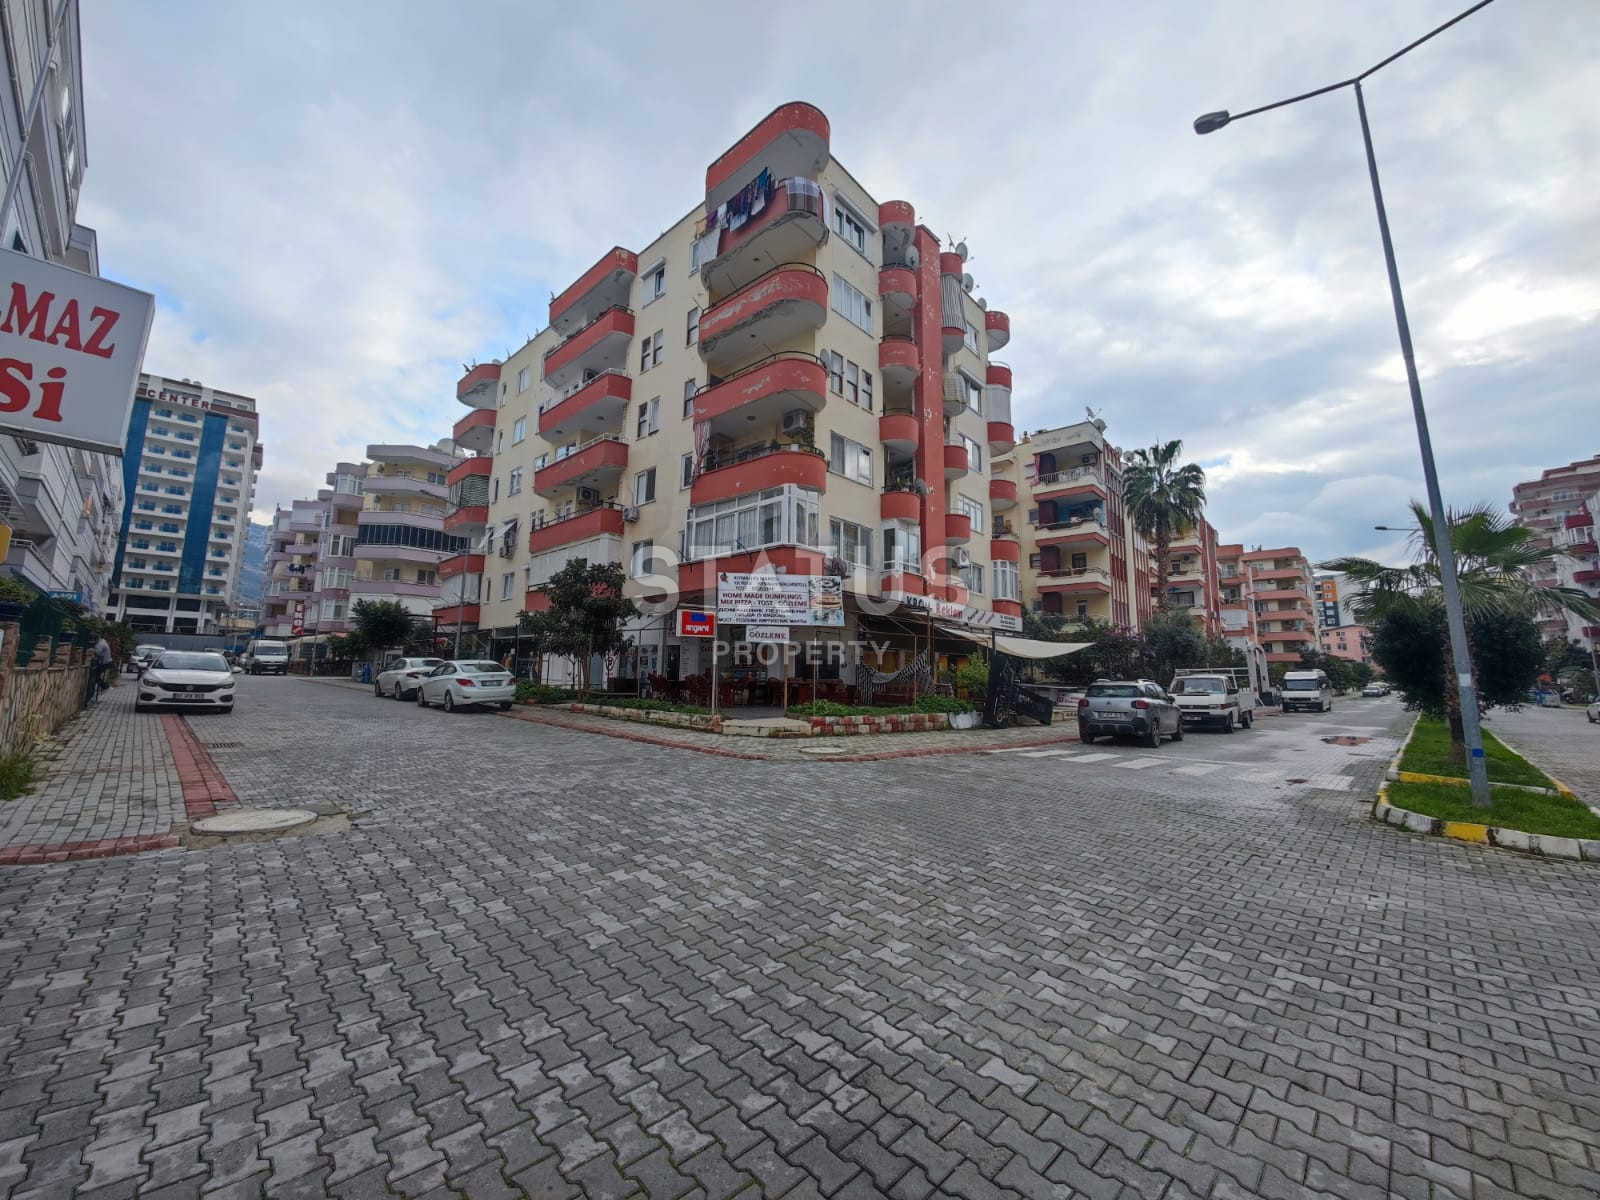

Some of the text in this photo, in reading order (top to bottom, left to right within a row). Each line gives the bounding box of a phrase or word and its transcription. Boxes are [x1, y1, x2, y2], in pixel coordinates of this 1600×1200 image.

[0, 282, 120, 358] MAZ
[147, 389, 210, 410] CENTER
[935, 602, 963, 620] Reklam
[749, 630, 786, 640] GÖZLEME
